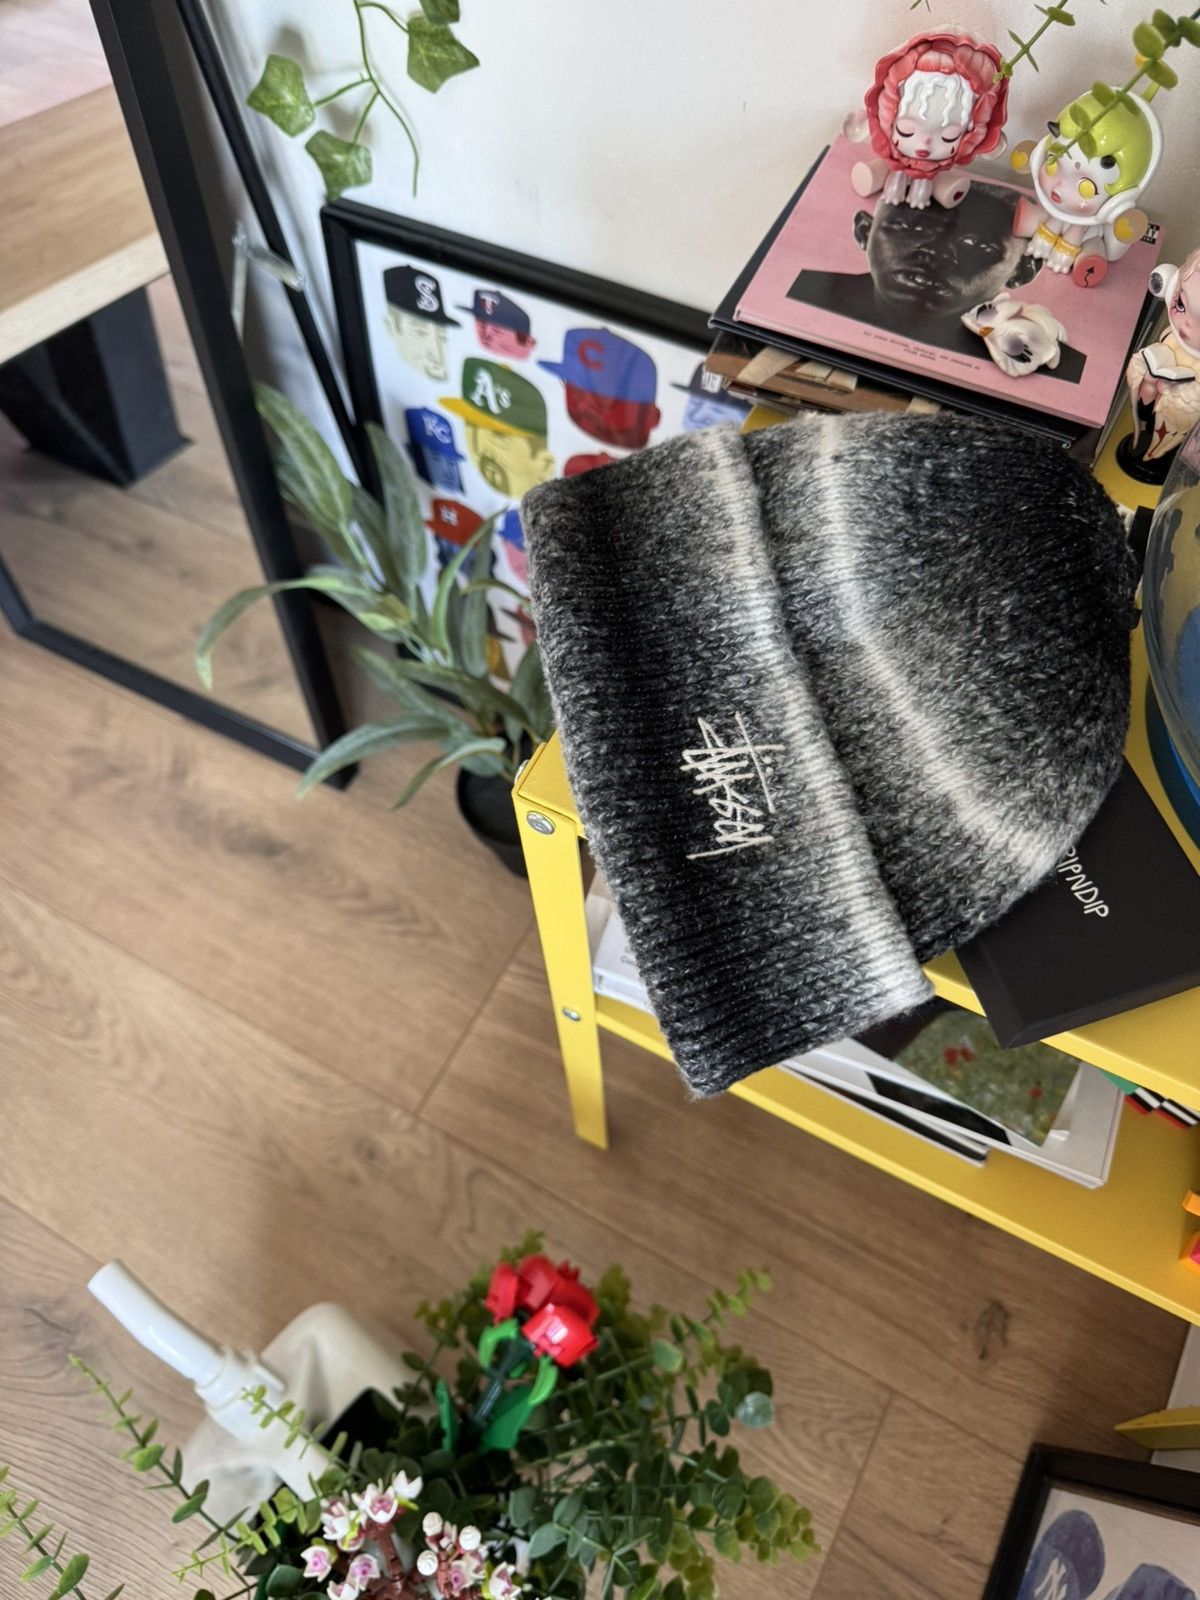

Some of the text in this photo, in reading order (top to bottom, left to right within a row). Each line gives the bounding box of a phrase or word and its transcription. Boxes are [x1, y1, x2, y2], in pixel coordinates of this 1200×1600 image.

[415, 275, 439, 312] S
[479, 290, 501, 316] T
[579, 340, 604, 370] C
[471, 370, 511, 413] A's
[423, 416, 450, 444] KC
